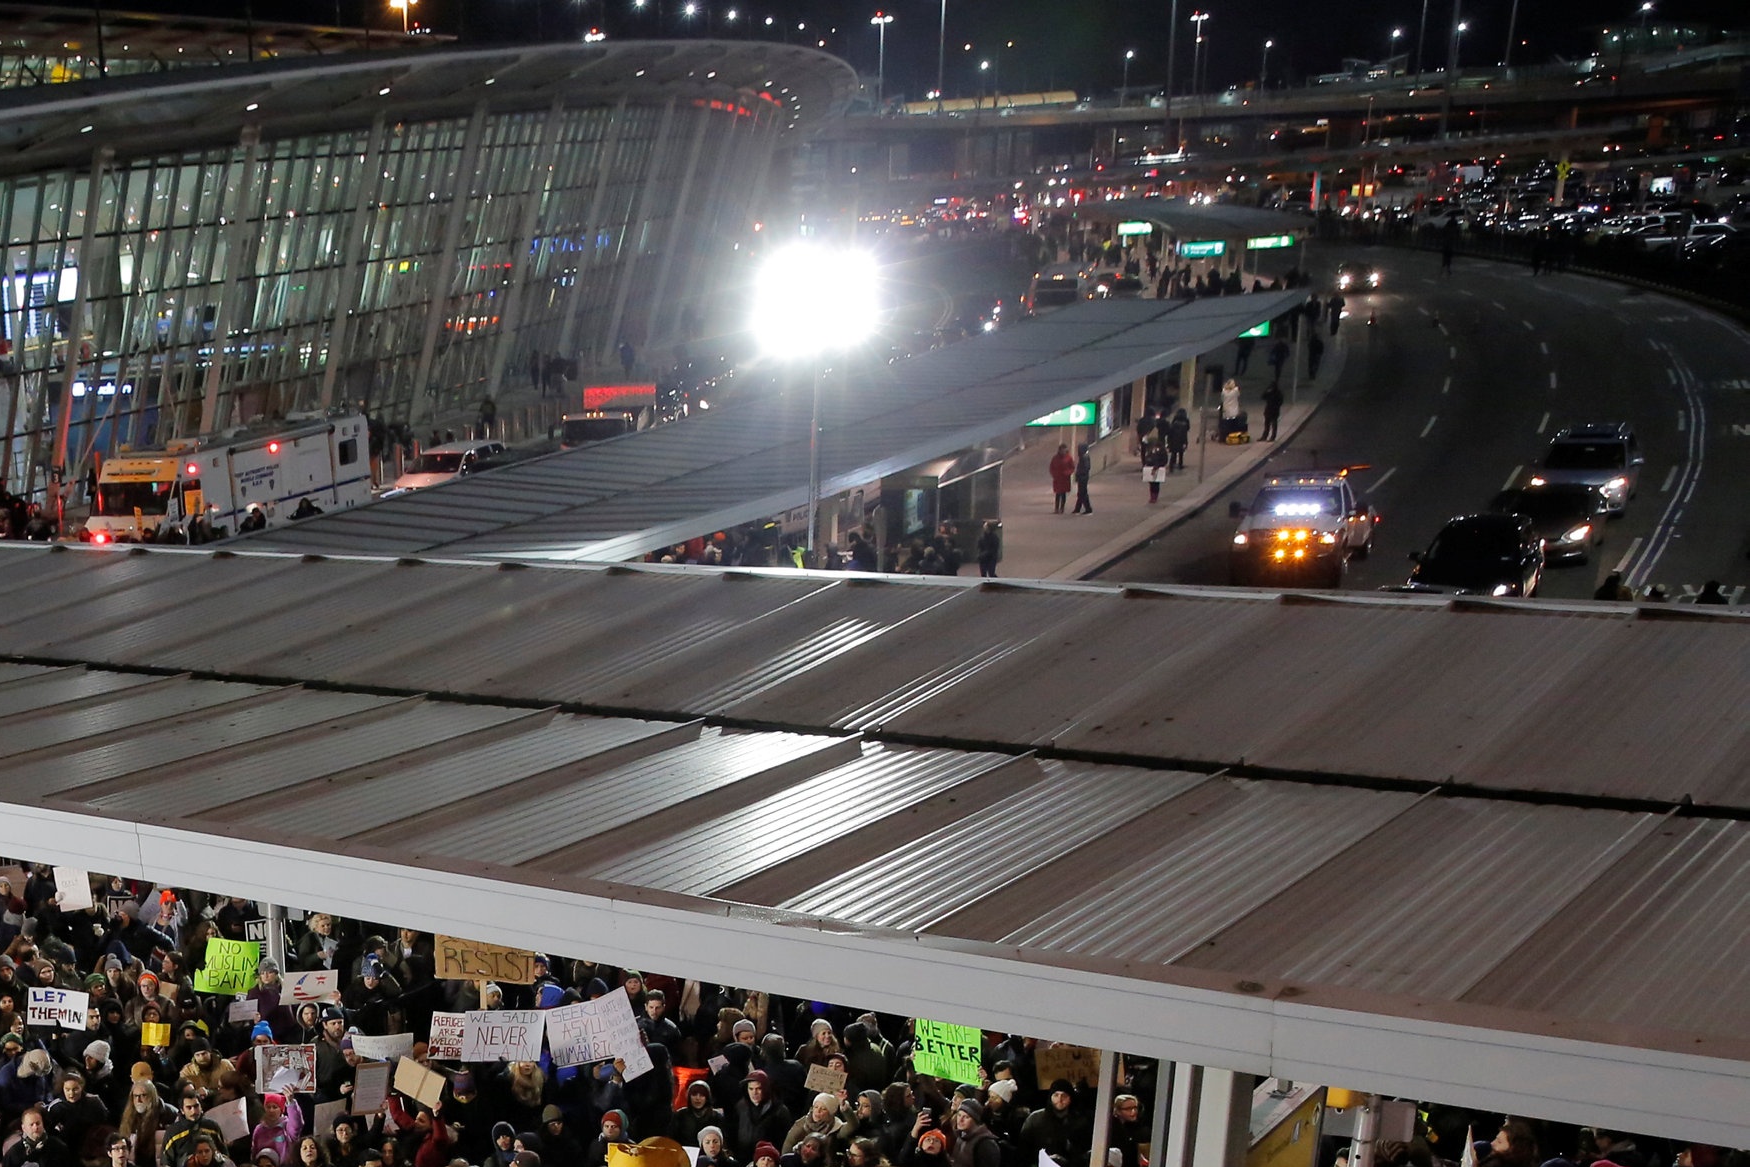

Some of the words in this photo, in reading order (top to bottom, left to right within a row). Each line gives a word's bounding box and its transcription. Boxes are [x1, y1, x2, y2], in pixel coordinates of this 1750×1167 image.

[1070, 404, 1086, 423] D
[219, 941, 242, 955] NO
[206, 956, 259, 972] MUSLIM
[445, 946, 535, 982] RESIST
[208, 970, 247, 989] BAN
[32, 991, 66, 1004] LET
[433, 1016, 465, 1028] REFUGEE
[470, 1011, 497, 1024] WE
[502, 1011, 538, 1024] SAID
[477, 1025, 528, 1046] NEVER
[920, 1020, 941, 1039] WE
[947, 1021, 971, 1044] ARE
[431, 1037, 463, 1047] WELCOM
[914, 1035, 981, 1064] BETTER
[923, 1054, 950, 1075] THAN
